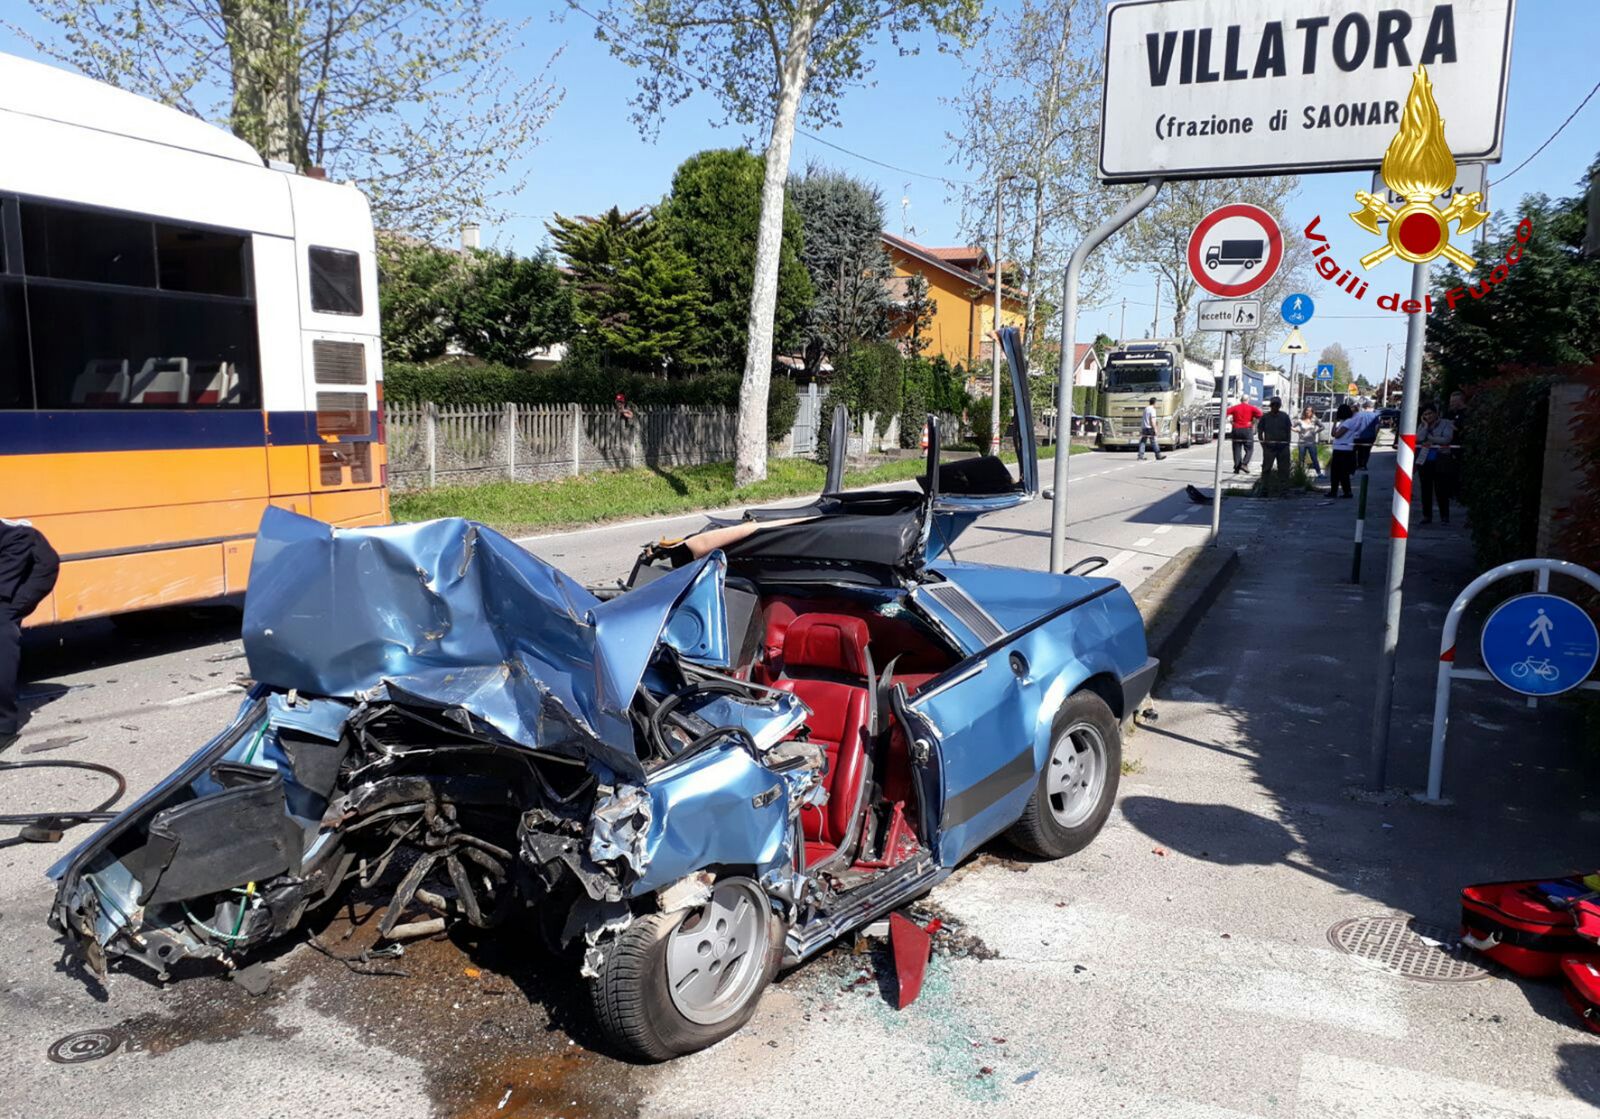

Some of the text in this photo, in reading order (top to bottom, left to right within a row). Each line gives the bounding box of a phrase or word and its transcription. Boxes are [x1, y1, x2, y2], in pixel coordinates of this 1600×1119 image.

[1146, 4, 1458, 87] VILLATORA
[1155, 100, 1400, 141] (frazione di SAONAR
[1201, 311, 1232, 321] eccetto
